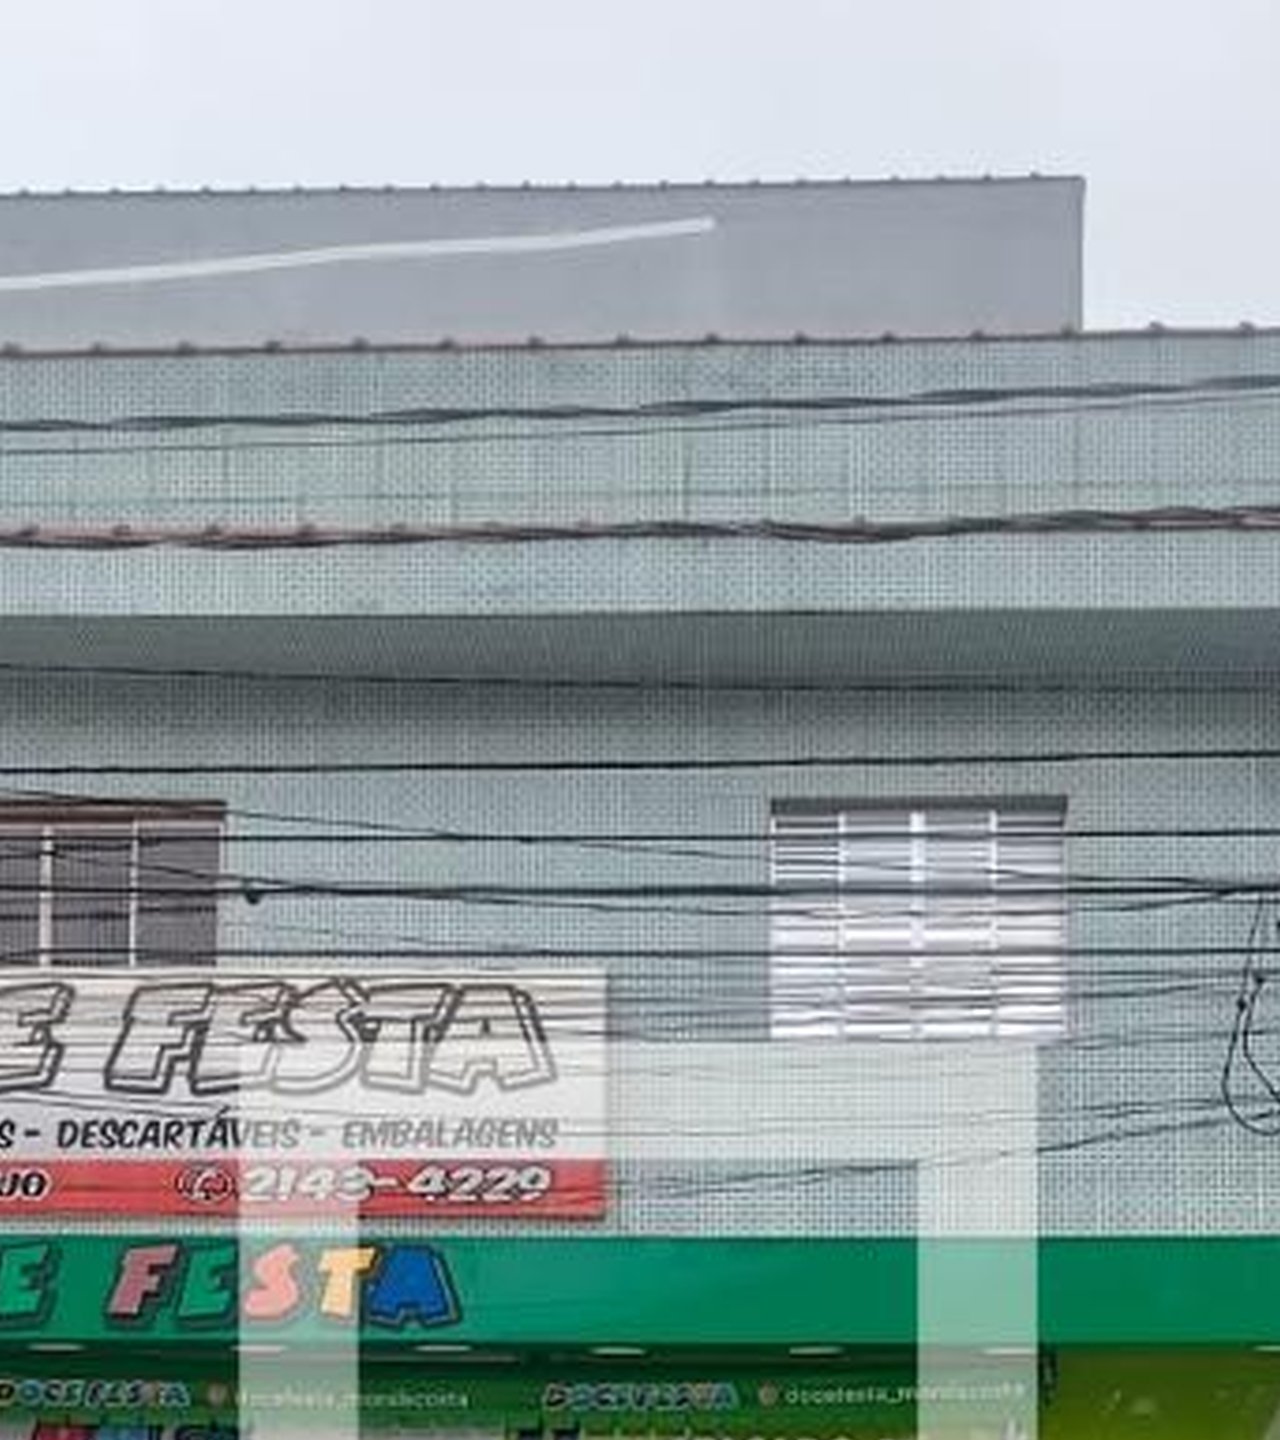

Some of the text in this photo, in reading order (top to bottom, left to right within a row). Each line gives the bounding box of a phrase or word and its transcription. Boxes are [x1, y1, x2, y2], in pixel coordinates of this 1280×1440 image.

[105, 977, 557, 1096] FESTA
[56, 1106, 299, 1150] DESCARTÁVEIS
[342, 1117, 559, 1150] EMBALAGENS
[105, 1243, 464, 1329] FESTA
